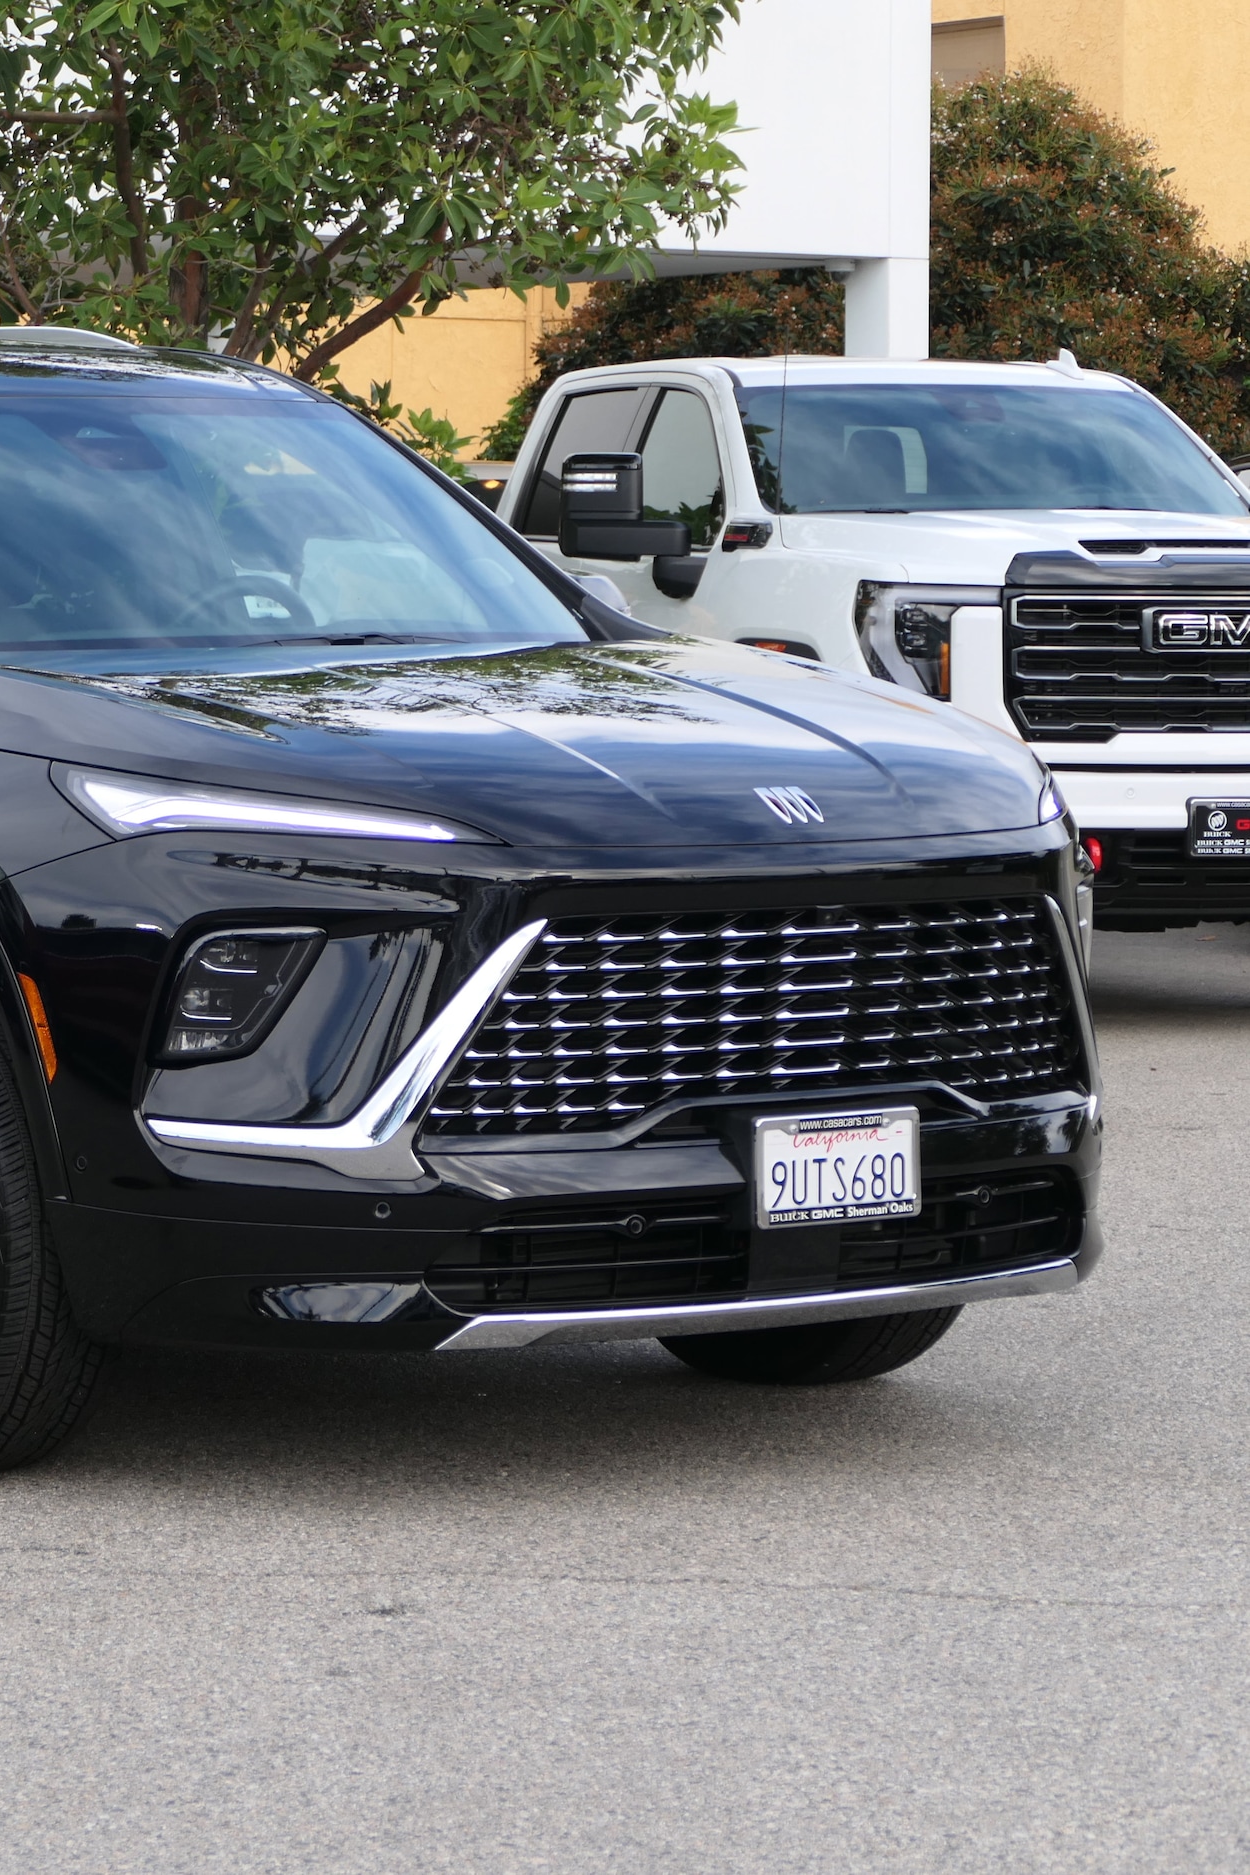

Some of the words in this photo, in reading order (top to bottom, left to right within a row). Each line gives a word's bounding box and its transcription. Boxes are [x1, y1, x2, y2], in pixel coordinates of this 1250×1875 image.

[799, 1114, 882, 1130] www.casacars.com
[793, 1128, 888, 1152] California
[771, 1152, 905, 1208] 9UTS680
[770, 1211, 810, 1223] BUICK
[811, 1208, 844, 1219] GMC
[847, 1204, 888, 1217] Sherman
[890, 1202, 914, 1213] Oaks
